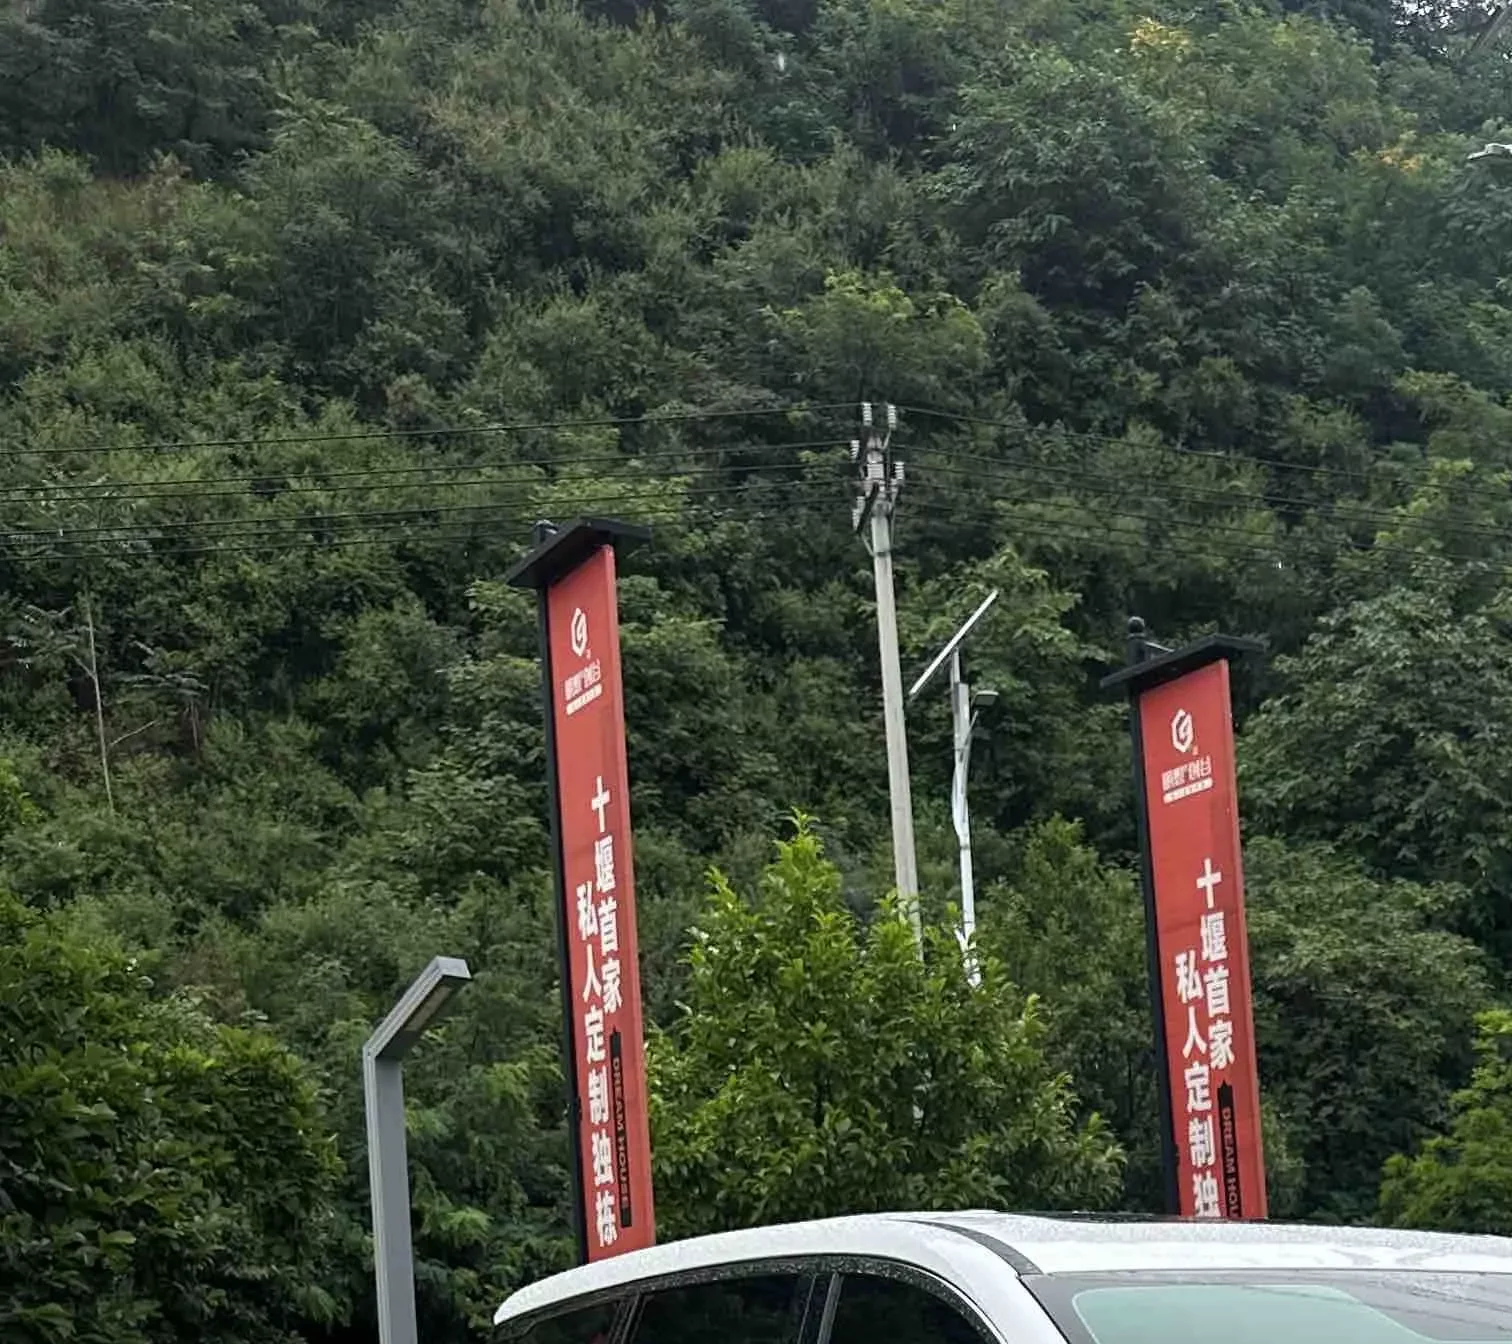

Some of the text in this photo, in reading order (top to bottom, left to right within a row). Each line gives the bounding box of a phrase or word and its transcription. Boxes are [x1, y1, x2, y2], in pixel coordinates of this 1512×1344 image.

[591, 775, 622, 1013] 十堰首家
[1196, 858, 1234, 1070] 十堰首家
[576, 880, 618, 1247] 私人定制独栋
[613, 1057, 630, 1209] DREAM HOUSE
[1222, 1106, 1236, 1172] DREAM
